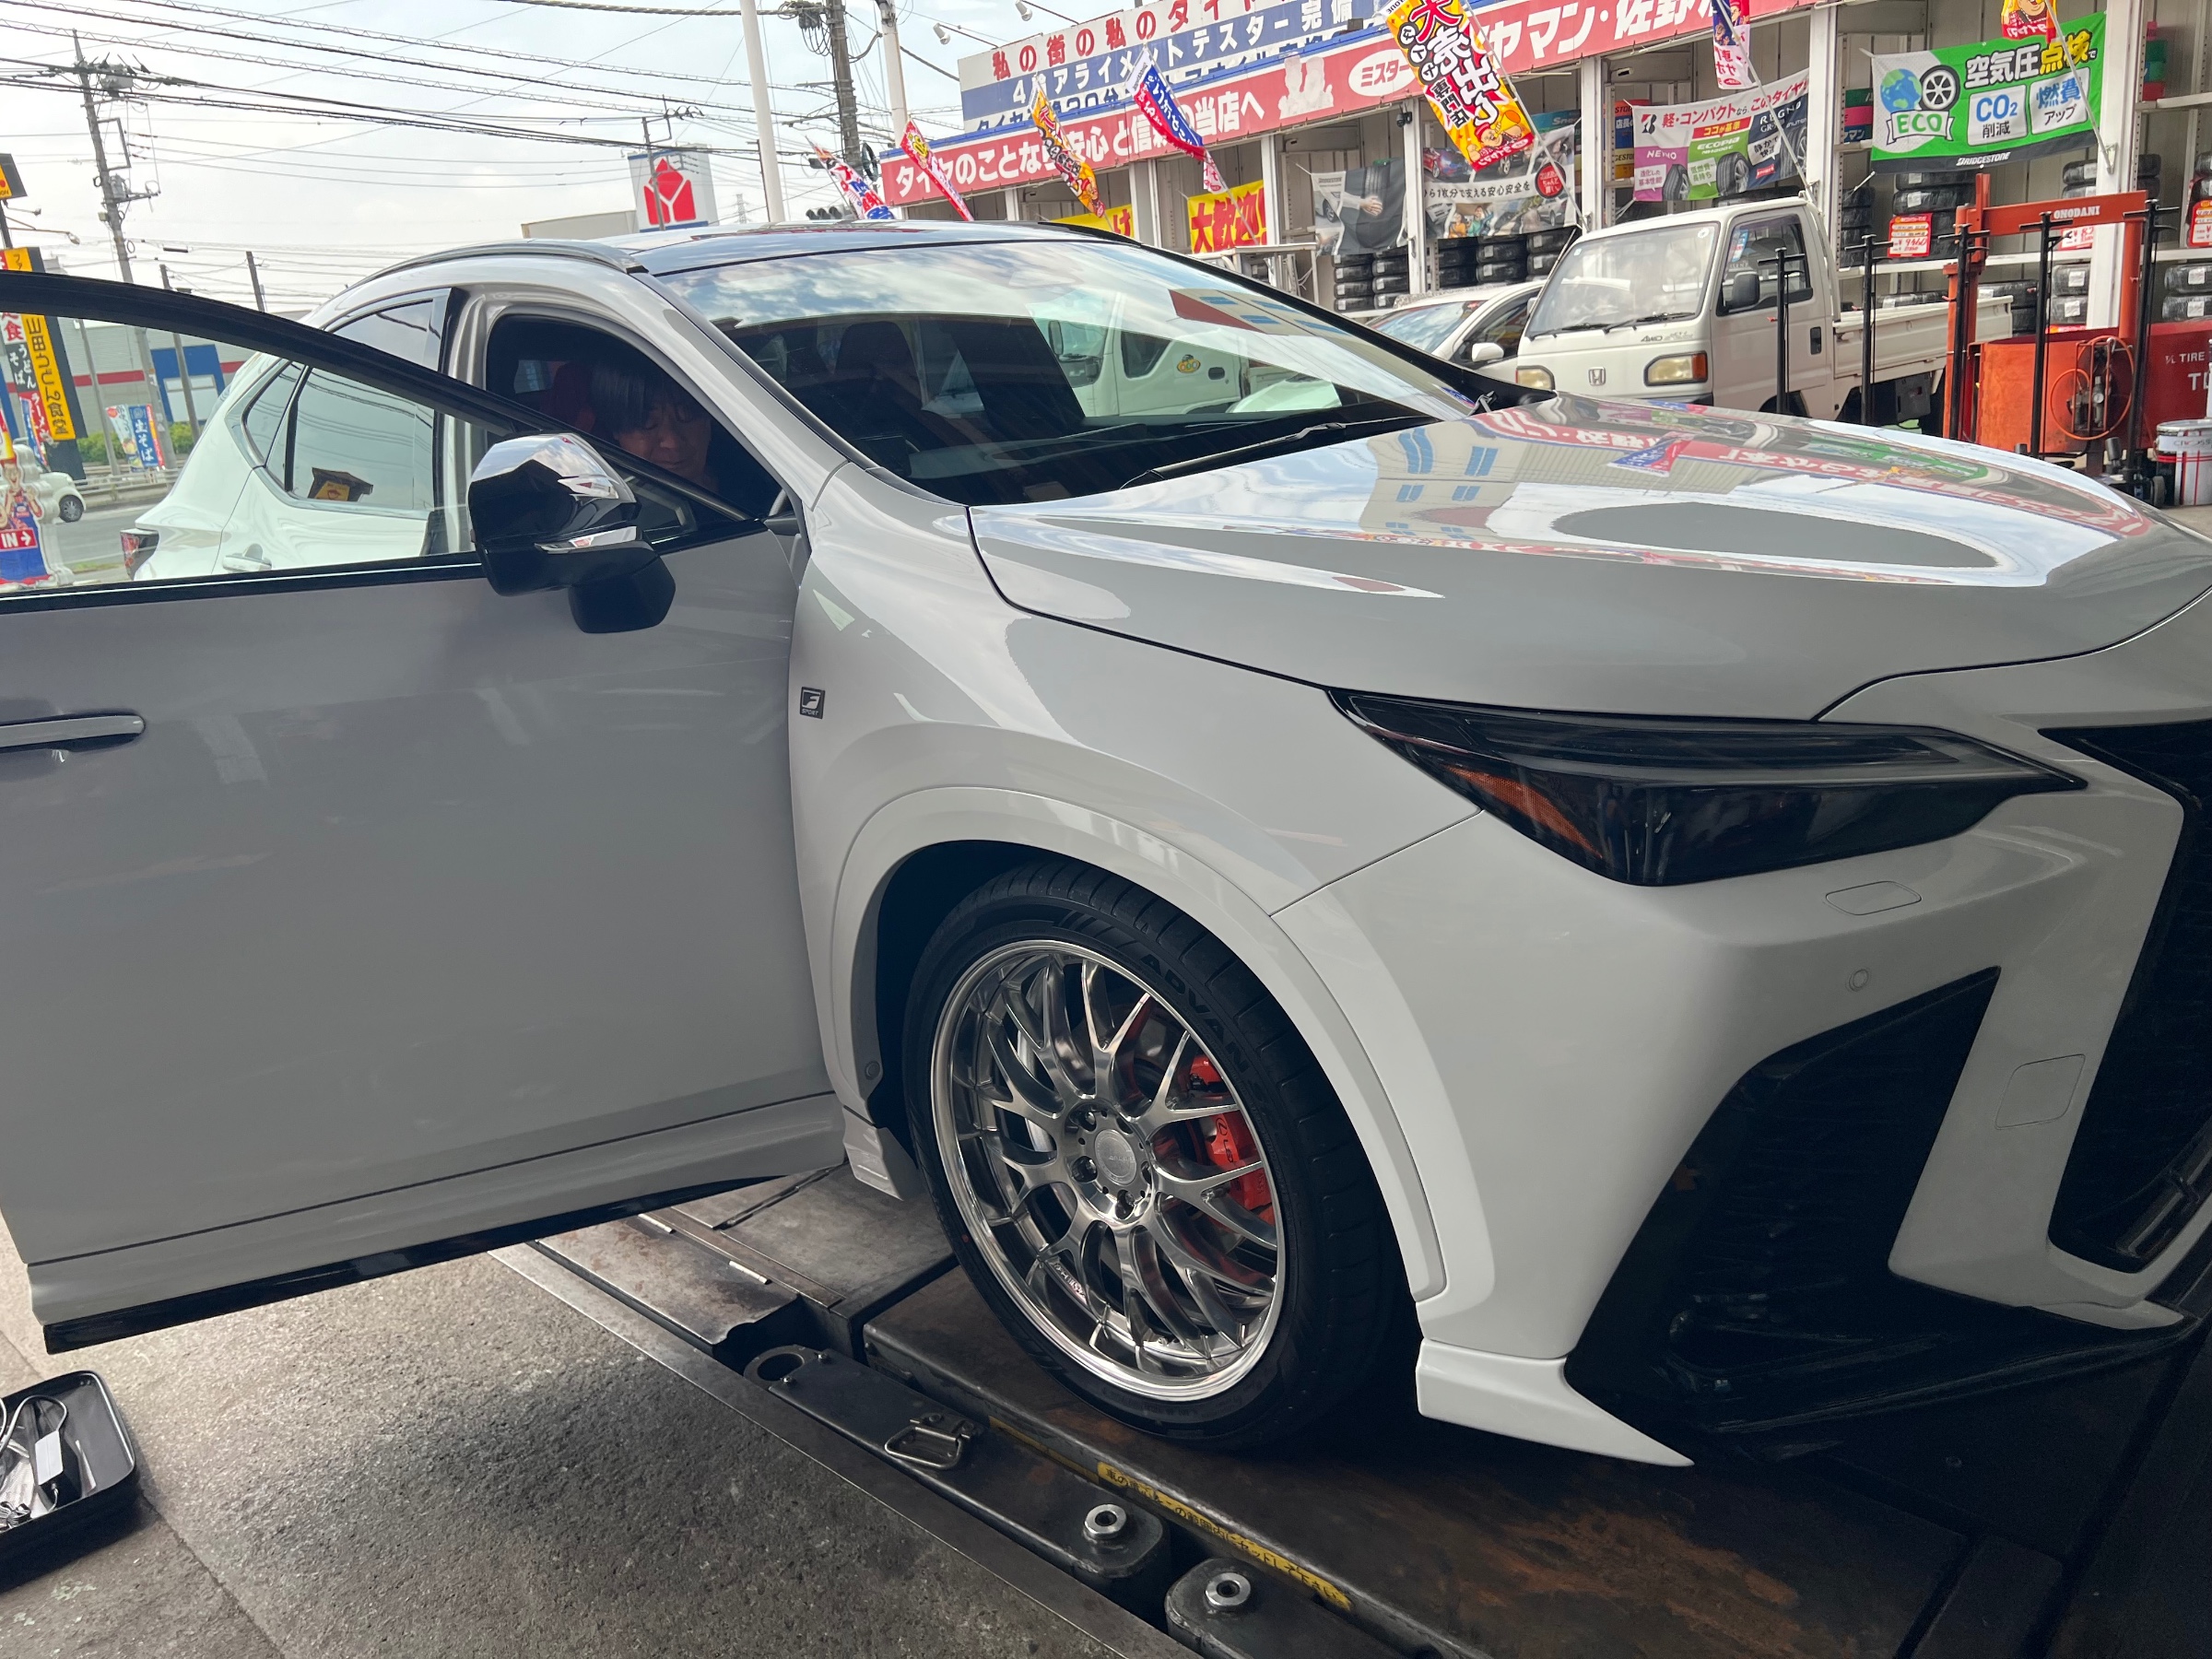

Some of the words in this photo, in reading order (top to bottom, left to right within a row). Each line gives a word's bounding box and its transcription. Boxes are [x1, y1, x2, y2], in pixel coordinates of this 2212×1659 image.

[1360, 59, 1410, 88] ミスター
[1897, 112, 1943, 134] ECO
[2044, 104, 2077, 125] アップ
[1982, 121, 2011, 138] 削減
[1956, 152, 2011, 167] BRIDGESTONE
[1424, 181, 1530, 199] ら1枚分で支える安心安全を
[2053, 206, 2100, 220] ONODANI
[18, 344, 36, 389] うどん
[2179, 351, 2206, 363] TIRE
[9, 352, 26, 385] そば
[26, 317, 69, 435] 山田うどん食堂
[135, 418, 155, 462] 生そば
[1, 533, 18, 548] IN
[1139, 953, 1250, 1074] ADVAN
